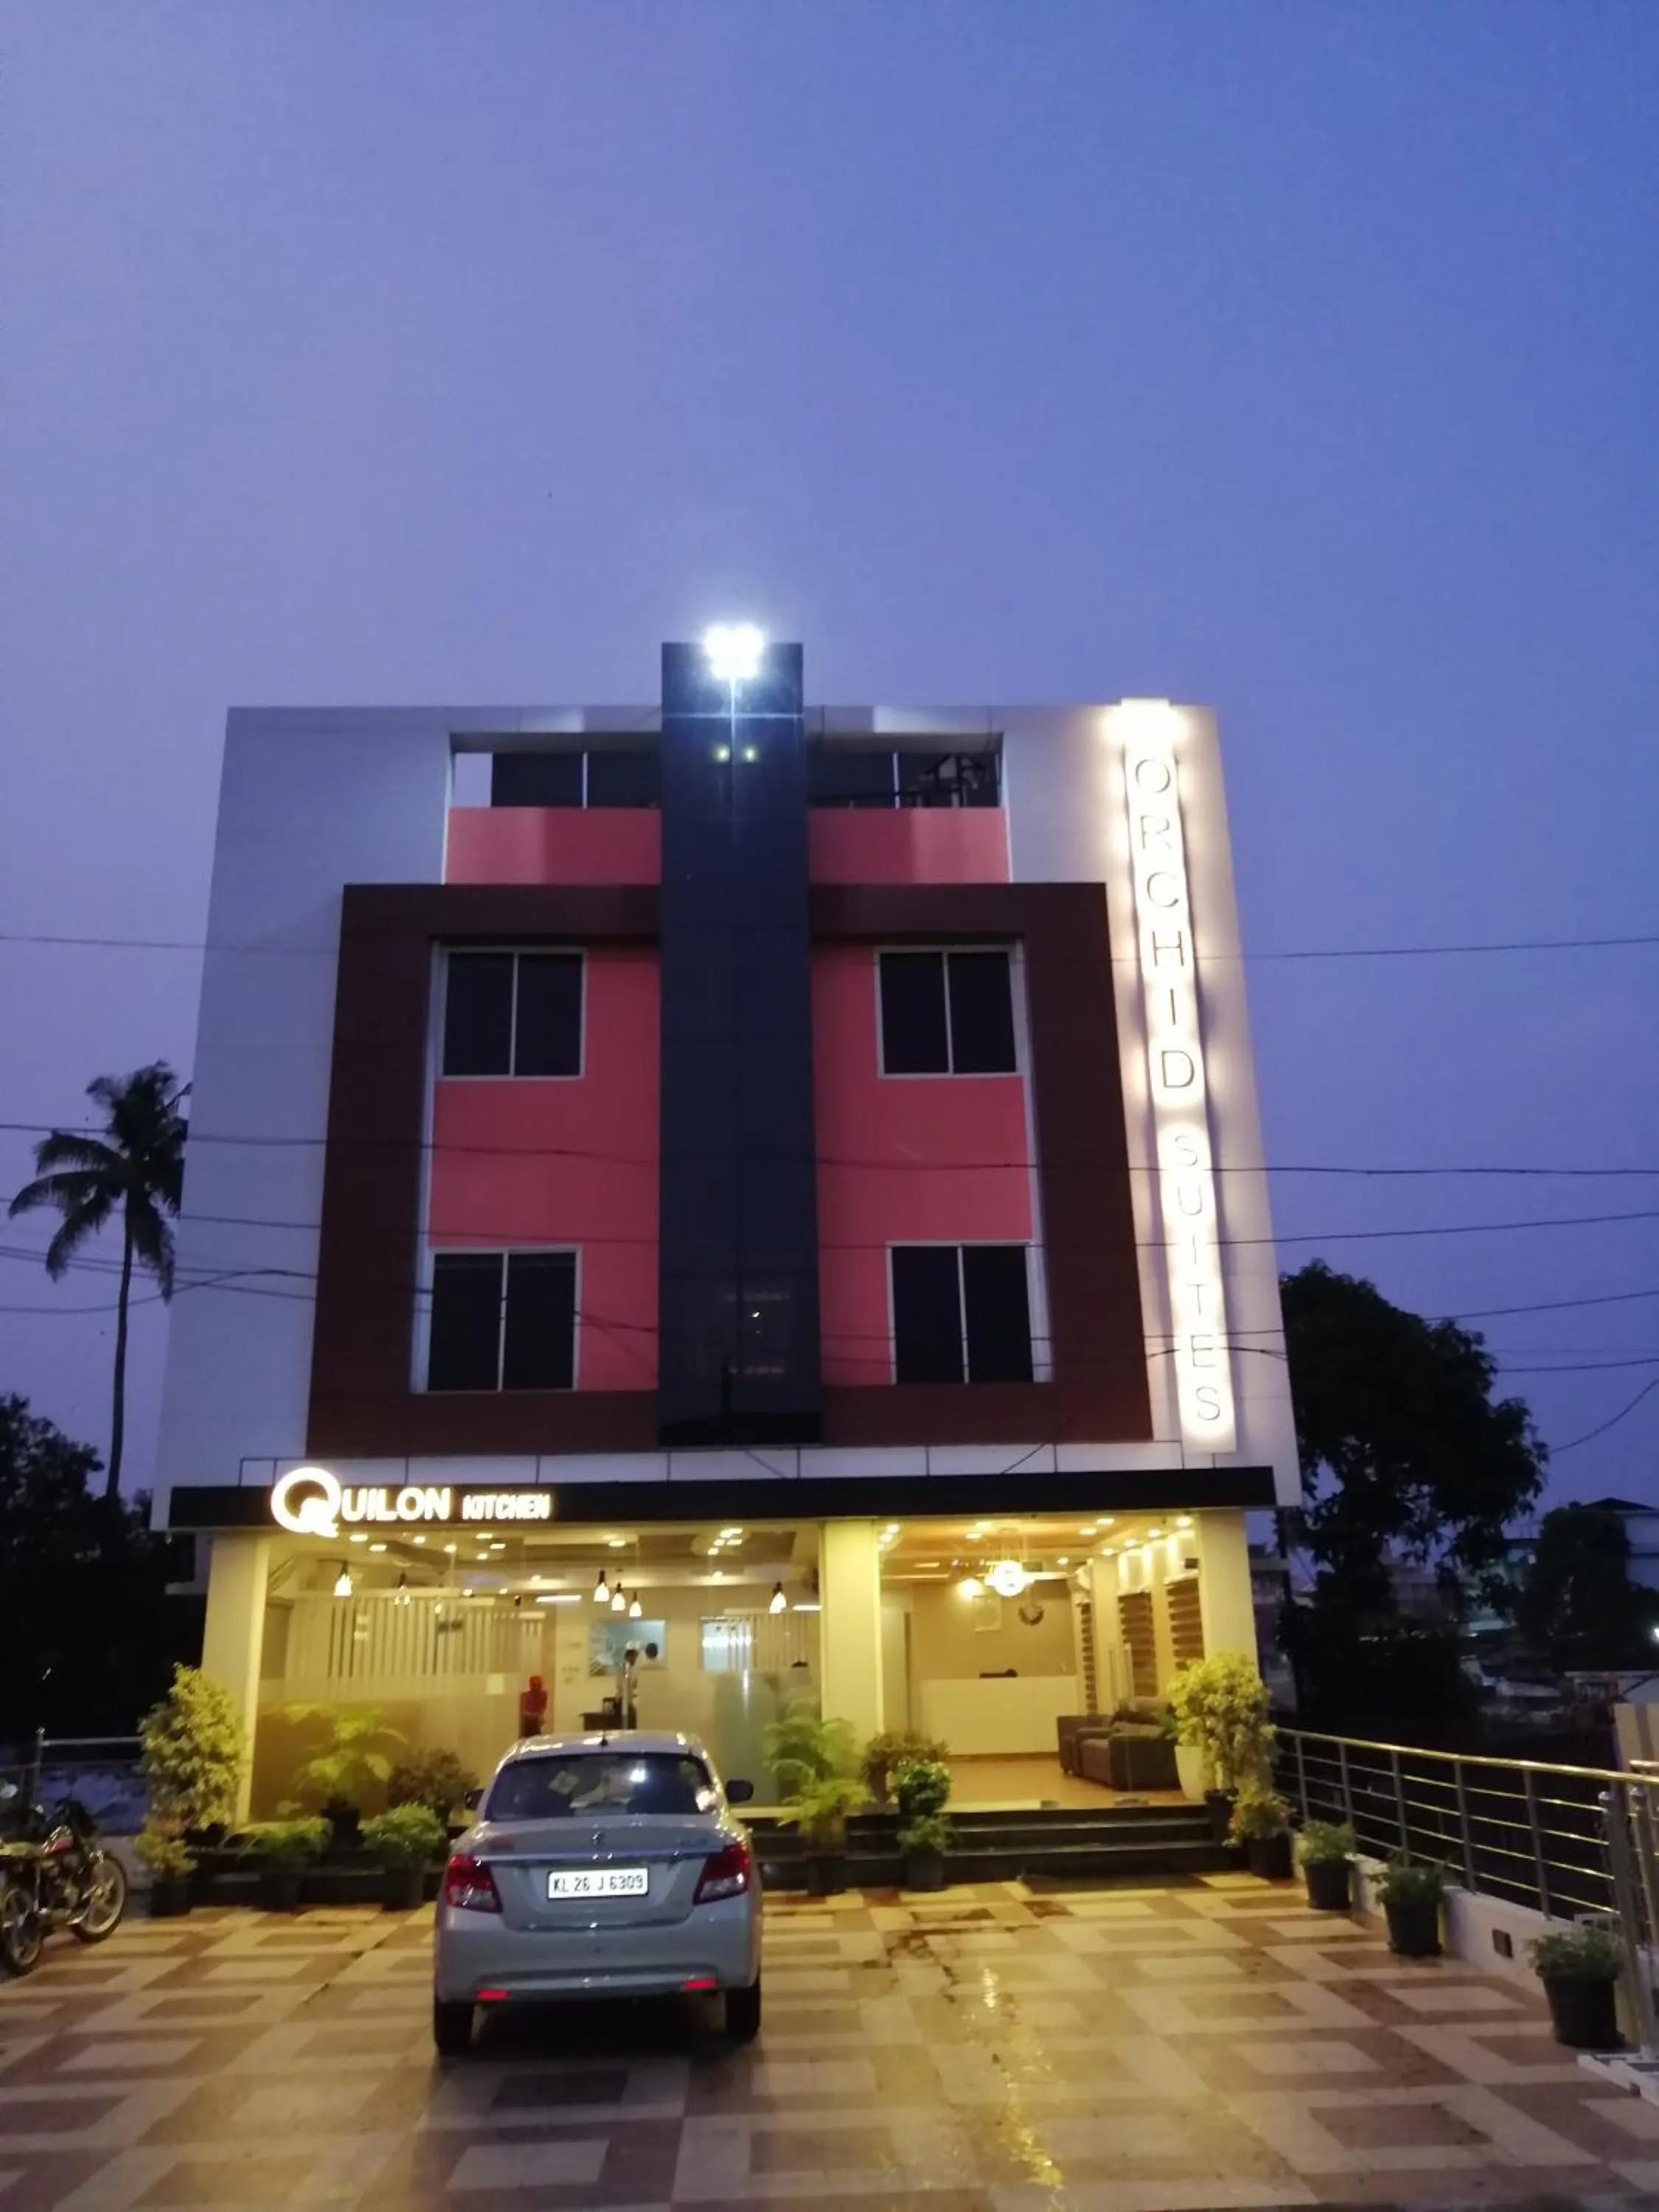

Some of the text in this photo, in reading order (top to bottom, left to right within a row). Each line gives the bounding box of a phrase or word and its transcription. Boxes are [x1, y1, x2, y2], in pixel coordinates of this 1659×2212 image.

[1135, 758, 1221, 1421] ORCHID SUITES
[271, 1467, 551, 1537] QUILON KITCHEN
[553, 1878, 568, 1892] KL
[597, 1876, 605, 1891] J
